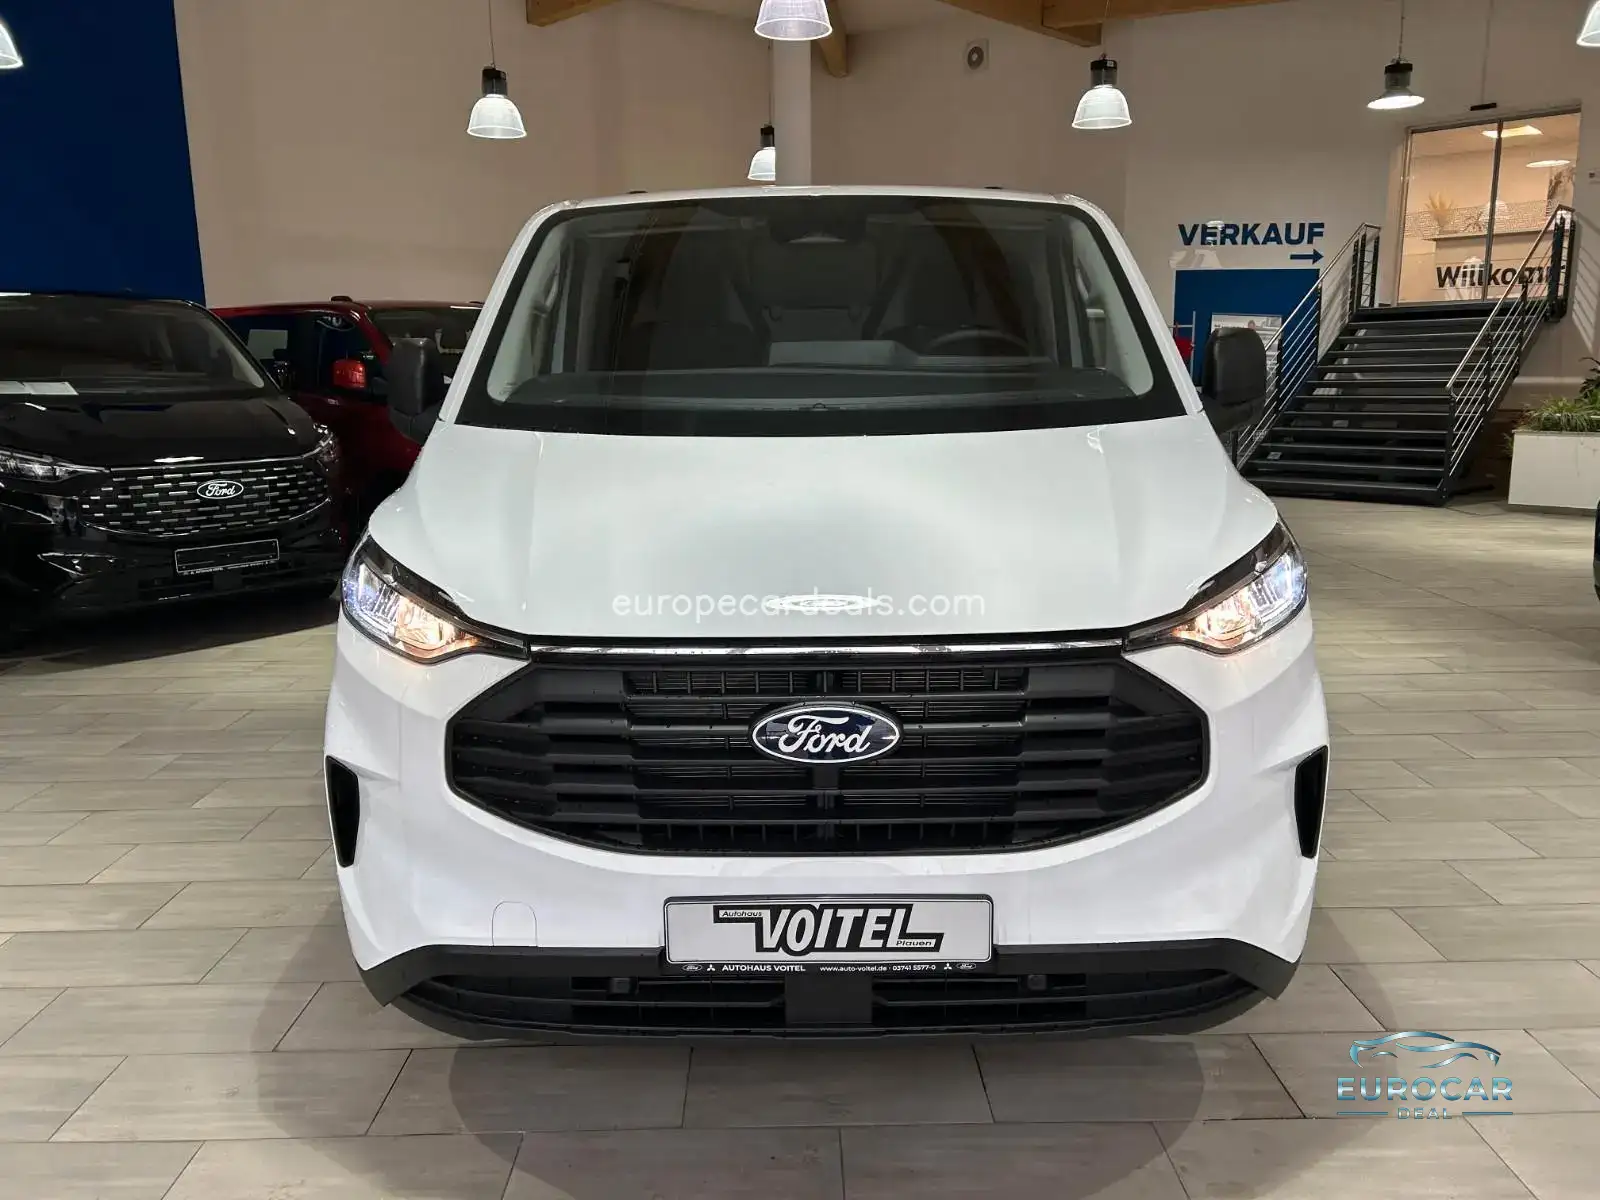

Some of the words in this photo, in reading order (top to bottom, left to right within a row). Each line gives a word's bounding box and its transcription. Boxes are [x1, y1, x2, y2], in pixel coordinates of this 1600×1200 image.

[1177, 222, 1325, 246] VERKAUF
[205, 482, 236, 497] Ford
[777, 714, 873, 754] Ford
[722, 910, 762, 918] Autohaus
[762, 908, 916, 952] VOITEL
[896, 939, 932, 947] Plauen
[721, 964, 772, 972] AUTOHAUS
[773, 964, 806, 972] VOITEL
[819, 964, 887, 972] www.auto-voitel.de
